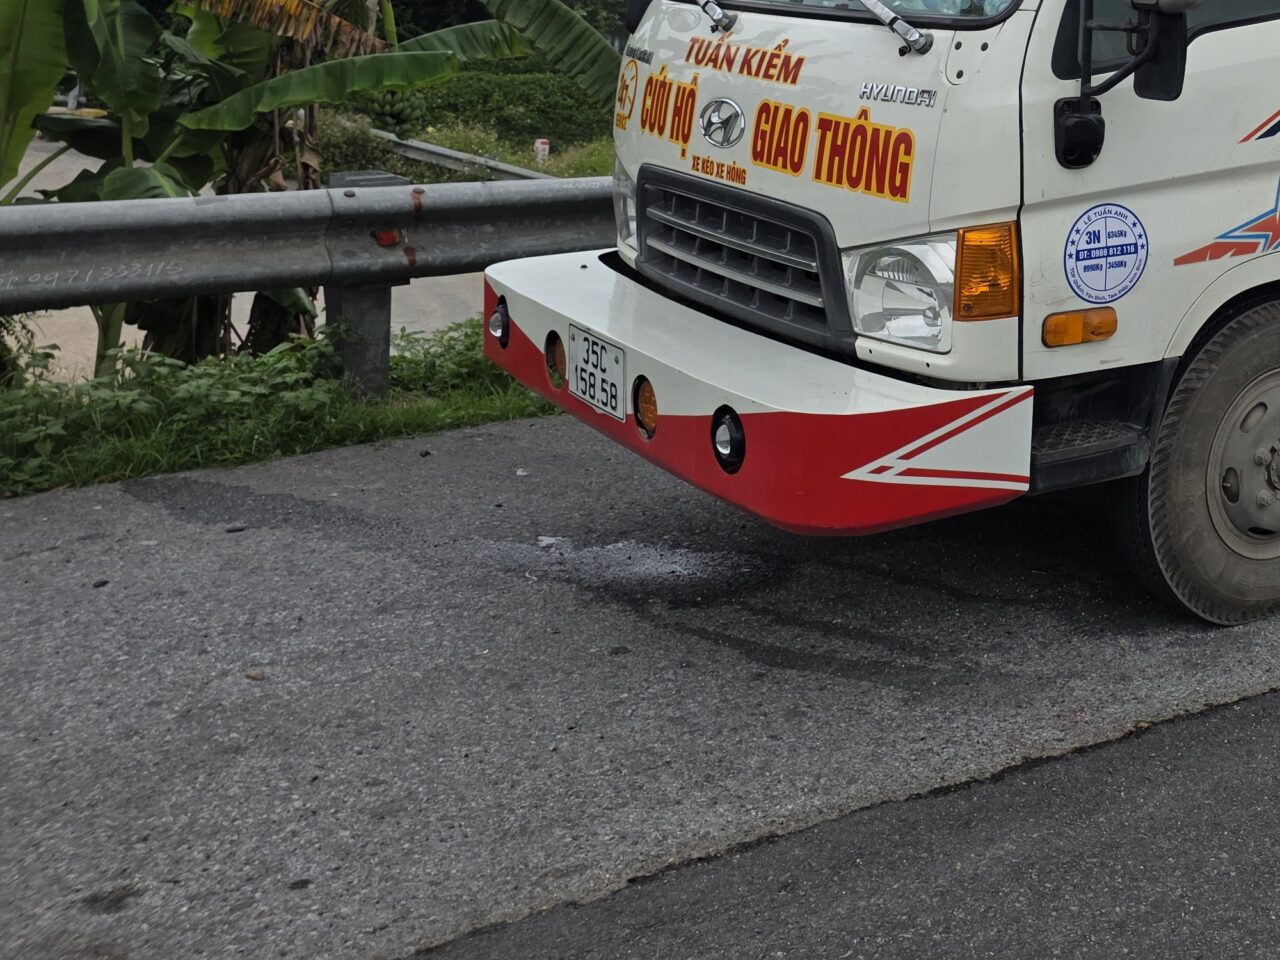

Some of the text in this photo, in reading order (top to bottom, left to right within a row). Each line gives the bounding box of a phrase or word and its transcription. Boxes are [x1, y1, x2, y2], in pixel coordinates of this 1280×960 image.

[684, 31, 739, 73] TUẤN
[738, 38, 806, 85] KIỂM
[859, 82, 937, 108] HYUNDAI
[639, 65, 699, 160] CỨU HỘ
[692, 155, 701, 172] XE
[701, 156, 714, 176] KÉO
[715, 161, 725, 179] XE
[752, 99, 916, 203] GIAO THÔNG
[1083, 207, 1128, 225] LÊ TUẤN ANH
[1085, 230, 1101, 245] 3N
[1091, 248, 1108, 258] 0988
[1109, 246, 1122, 255] 812
[1123, 244, 1135, 254] 116
[582, 336, 608, 374] 35C
[575, 364, 618, 411] 158.58
